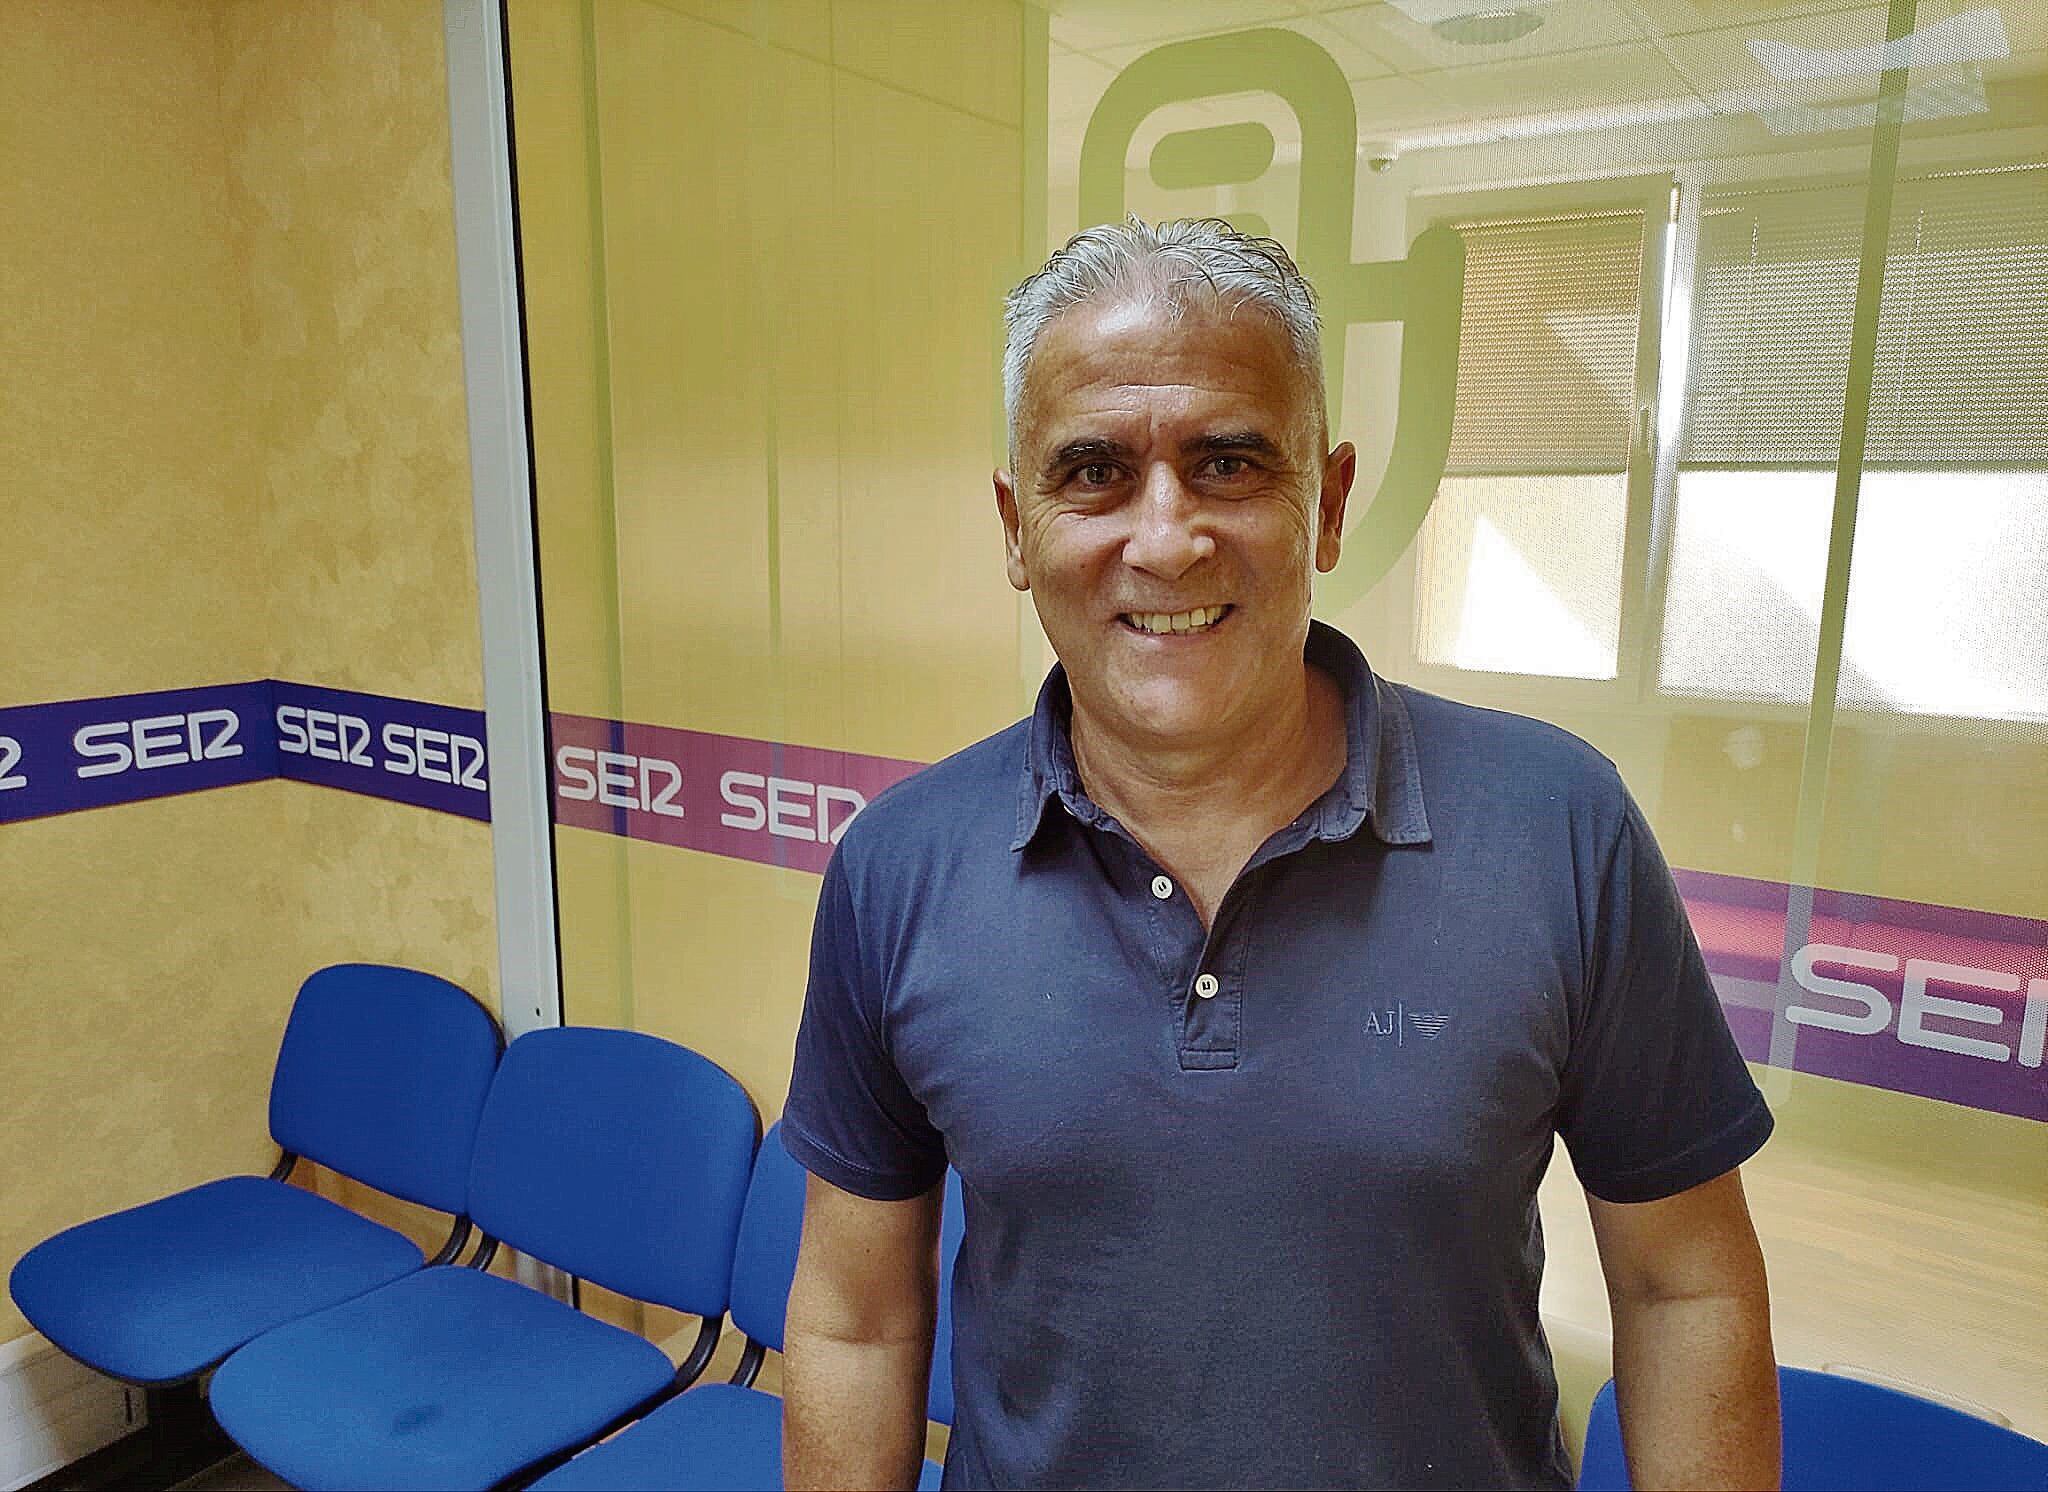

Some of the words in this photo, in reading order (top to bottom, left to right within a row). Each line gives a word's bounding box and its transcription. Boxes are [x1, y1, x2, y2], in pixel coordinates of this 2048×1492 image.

[74, 709, 243, 778] SER
[276, 705, 373, 767] SER
[382, 723, 487, 791] SER
[556, 745, 684, 817] SER
[1784, 943, 2048, 1068] SE
